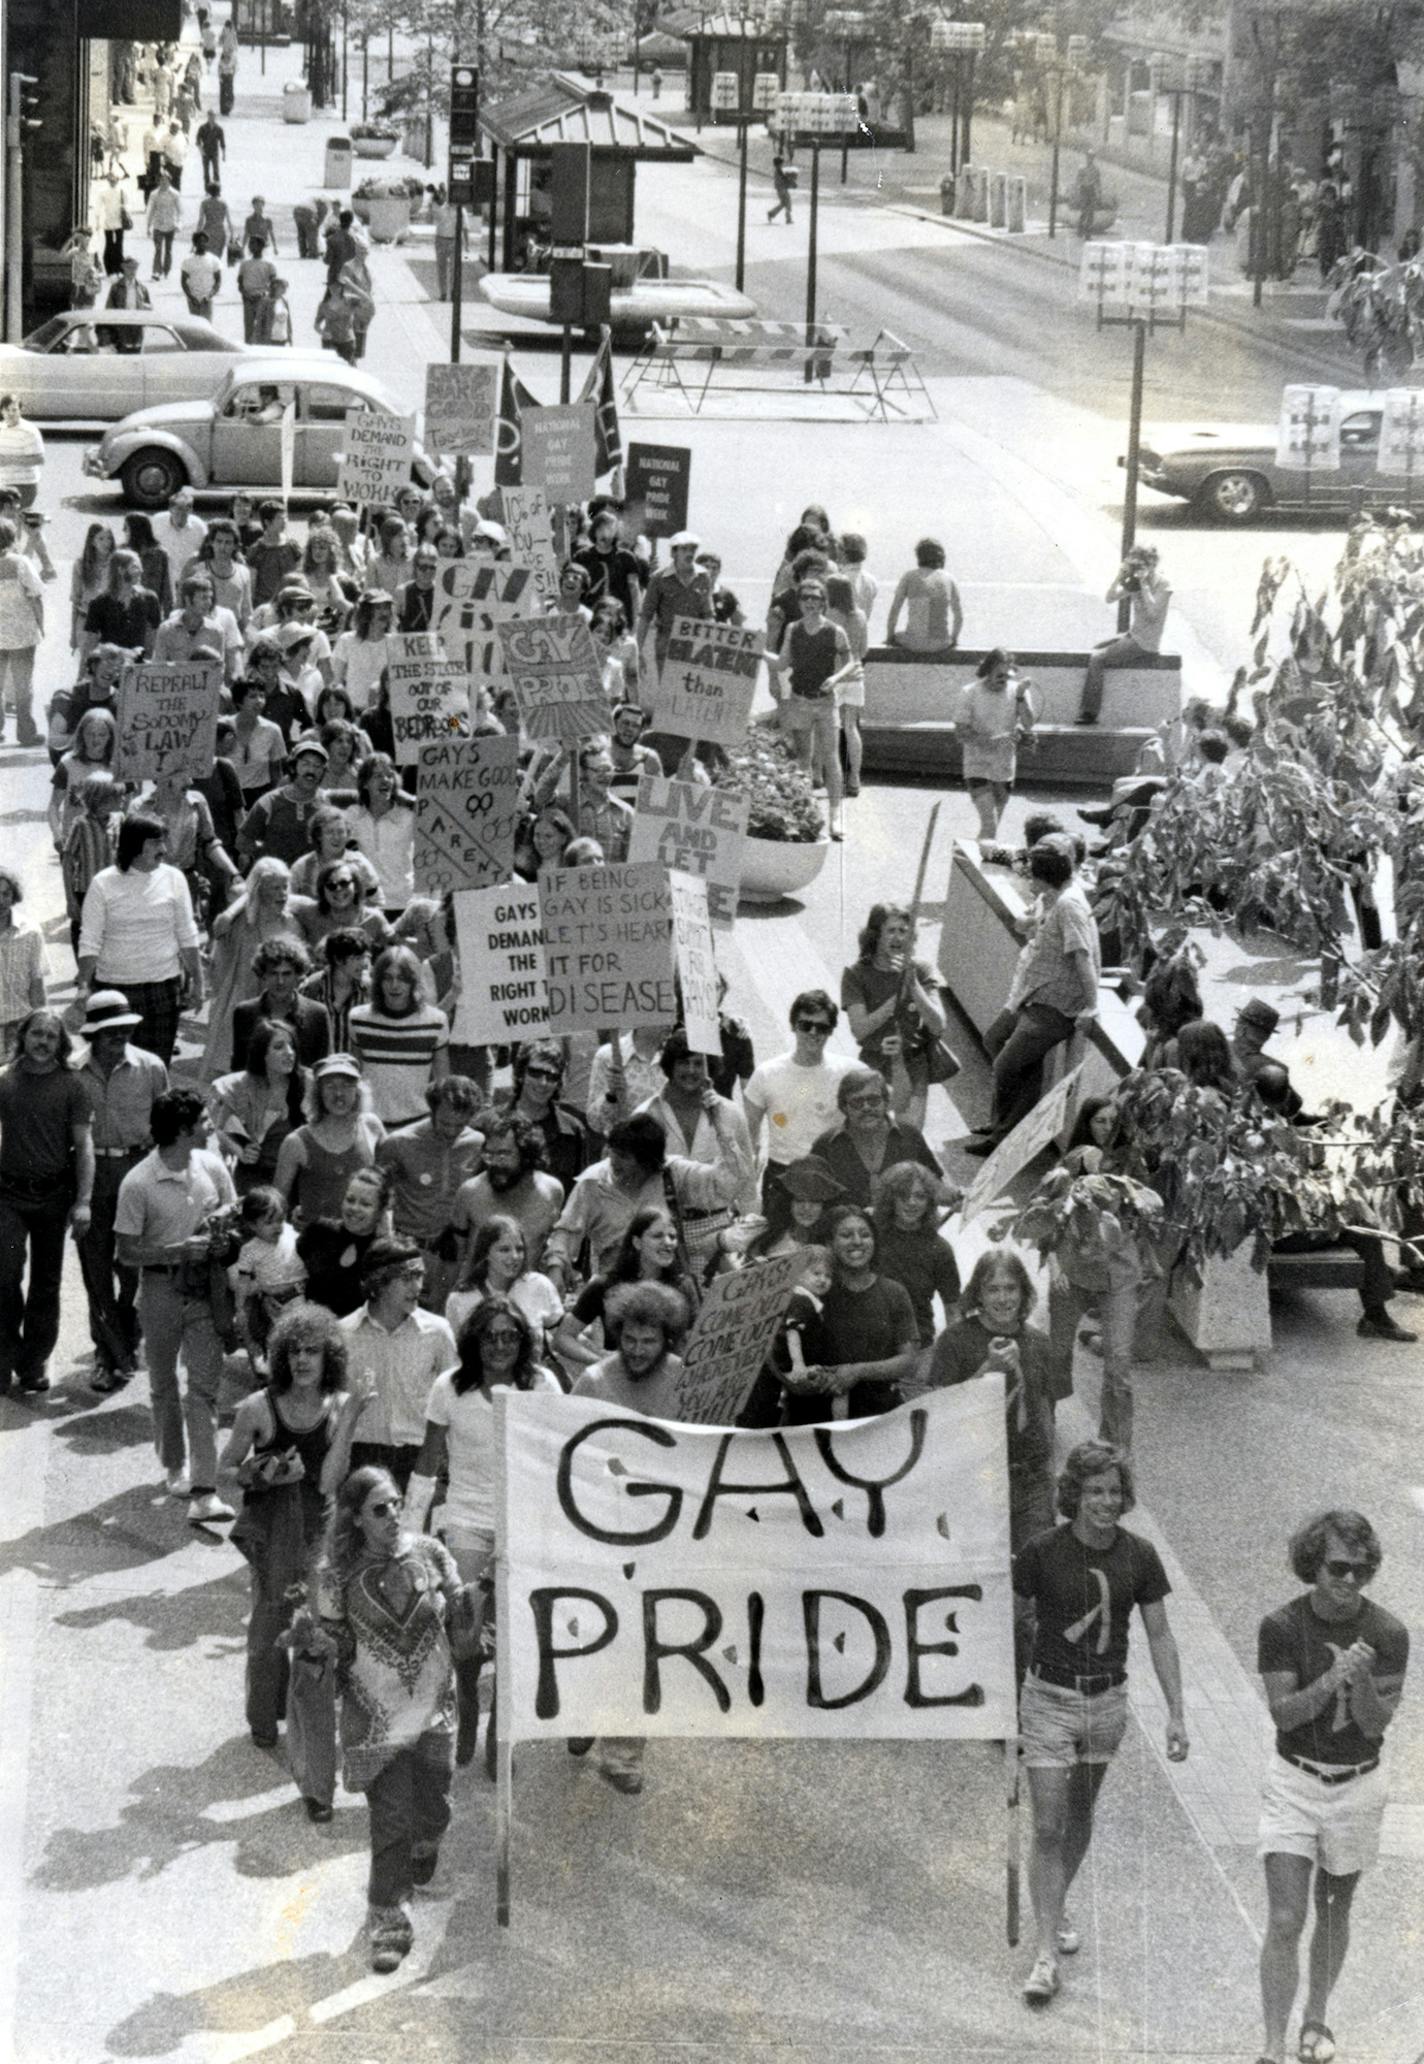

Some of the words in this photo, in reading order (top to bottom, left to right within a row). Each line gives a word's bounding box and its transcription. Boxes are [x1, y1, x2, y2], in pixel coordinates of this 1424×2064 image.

[351, 428, 407, 447] DEMAND
[361, 469, 382, 482] TO
[639, 457, 681, 472] NATIONAL
[648, 475, 669, 489] GAY
[442, 565, 531, 603] GAY
[510, 626, 584, 665] GAY
[680, 621, 756, 649] BETTER
[392, 663, 421, 679] THE
[409, 681, 432, 696] OUT
[434, 681, 452, 696] OF
[682, 672, 724, 697] than
[157, 697, 187, 711] THE
[417, 697, 442, 712] OUR
[145, 728, 198, 751] LAW
[423, 743, 479, 766] GAYS
[419, 770, 474, 790] MAKE
[479, 767, 517, 787] GOOD
[637, 775, 742, 833] LIVE
[659, 822, 717, 851] AND
[657, 845, 716, 874] LET
[546, 875, 568, 893] IF
[579, 868, 639, 891] BEING
[494, 903, 537, 923] GAYS
[544, 897, 590, 917] GAY
[598, 897, 612, 914] IS
[620, 892, 668, 914] SICK
[488, 929, 544, 951] DEMAN
[543, 923, 608, 945] LET'S
[616, 919, 669, 942] HEAR
[508, 953, 537, 972] THE
[549, 955, 570, 977] IT
[579, 952, 622, 974] FOR
[490, 981, 541, 1001] RIGHT
[549, 980, 674, 1016] DISEASE
[686, 1329, 741, 1367] COME
[557, 1407, 928, 1546] GAY
[529, 1584, 986, 1720] PRIDE
